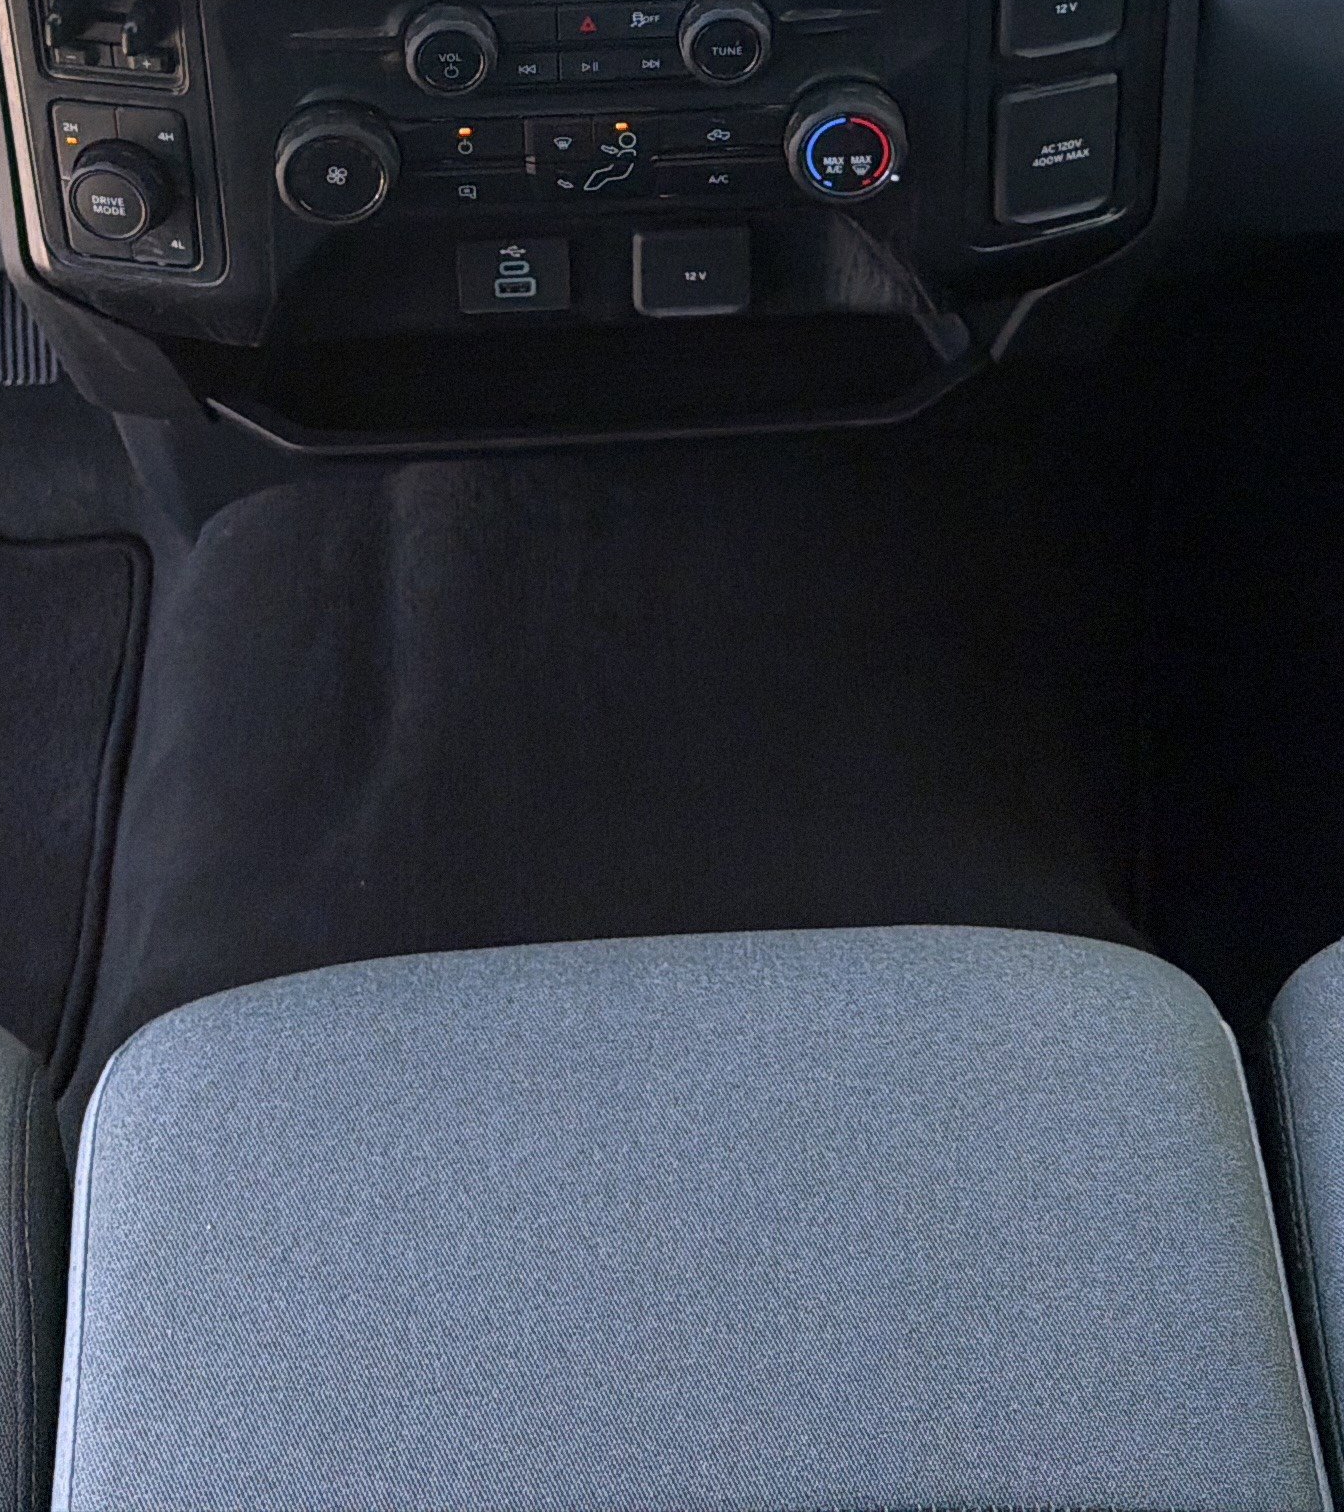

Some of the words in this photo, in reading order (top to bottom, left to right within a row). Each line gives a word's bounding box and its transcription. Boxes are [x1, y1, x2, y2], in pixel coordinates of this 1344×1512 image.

[642, 14, 661, 24] OFF
[711, 45, 744, 57] TUNE
[438, 52, 462, 63] VOL
[63, 122, 79, 133] 2H
[157, 131, 175, 142] 4H
[1041, 144, 1057, 156] AC
[1057, 138, 1083, 153] 120V
[823, 156, 845, 166] MAX
[850, 154, 873, 164] MAX
[1031, 153, 1064, 168] 400W
[1065, 147, 1090, 162] MAX
[708, 173, 729, 185] A/C
[91, 194, 125, 207] DRIVE
[92, 204, 126, 217] MODE
[170, 239, 186, 250] 4L
